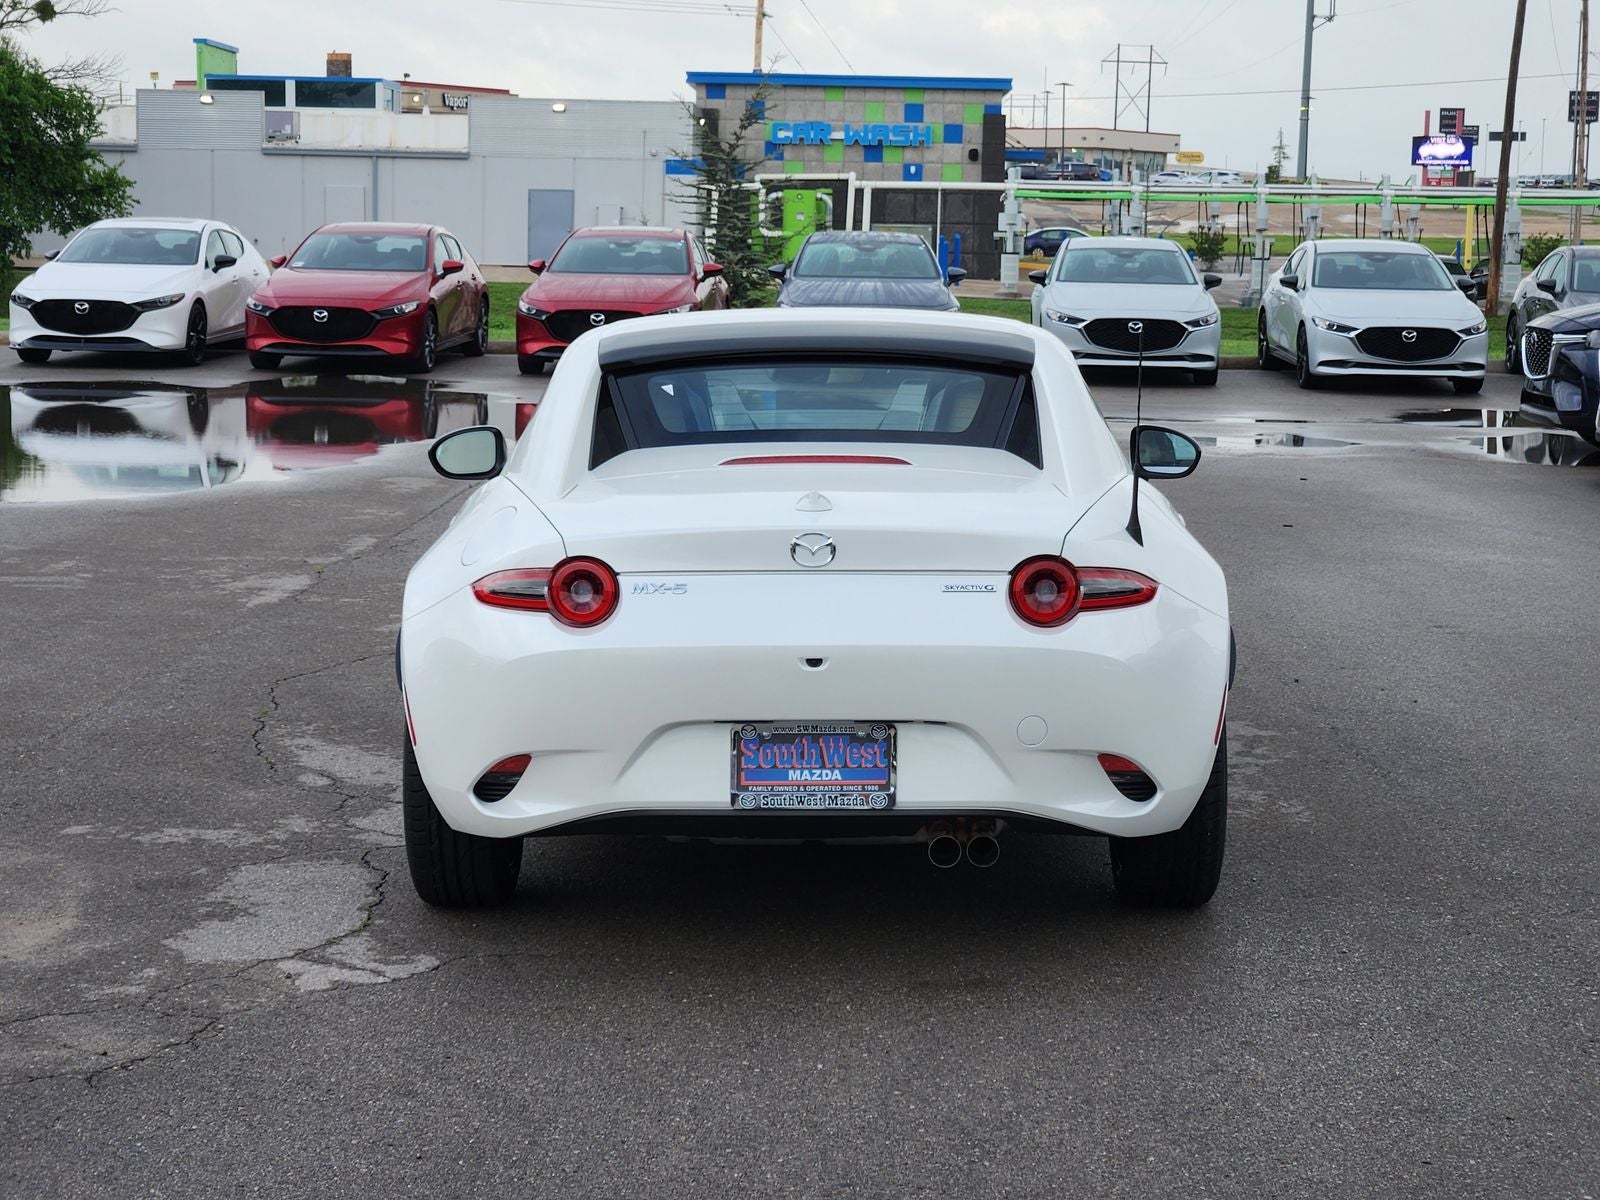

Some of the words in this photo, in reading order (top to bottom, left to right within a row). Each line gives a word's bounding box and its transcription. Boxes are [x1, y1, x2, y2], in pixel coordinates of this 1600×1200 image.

[443, 93, 468, 110] Vapor
[771, 121, 832, 145] CAR
[843, 123, 933, 147] WASH
[631, 582, 688, 595] MX-5
[772, 725, 856, 734] www.SWMazda.com
[740, 736, 889, 769] SouthWest
[788, 769, 842, 781] MAZDA
[761, 794, 824, 807] SouthWest
[827, 794, 865, 807] Mazda
